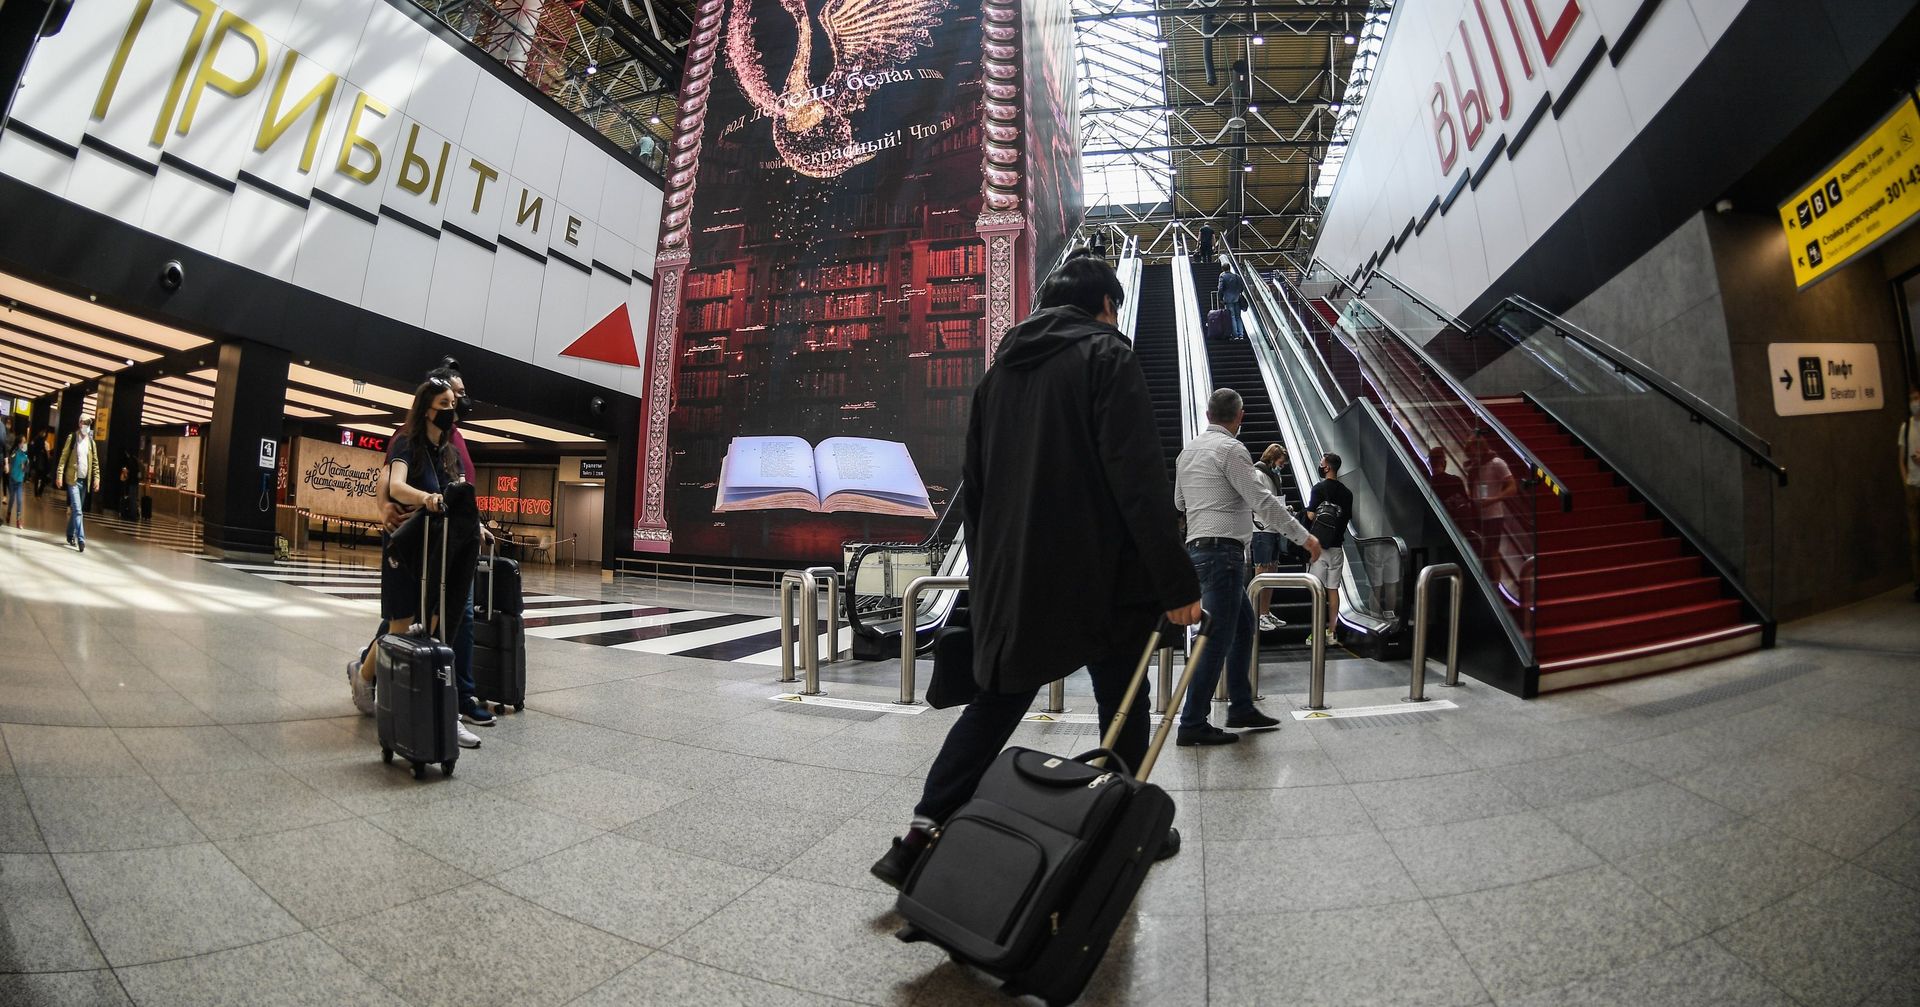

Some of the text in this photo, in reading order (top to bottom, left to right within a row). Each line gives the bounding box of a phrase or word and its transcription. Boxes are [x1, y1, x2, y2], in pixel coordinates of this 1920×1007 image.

[846, 68, 915, 91] белая
[91, 0, 582, 246] ПРИБЫТИЕ
[909, 124, 938, 140] Что
[1829, 183, 1839, 200] C
[1814, 195, 1824, 213] B
[1828, 360, 1853, 380] Лифт
[1831, 387, 1857, 400] Elevator
[358, 436, 384, 450] KFC
[497, 476, 519, 492] KFC
